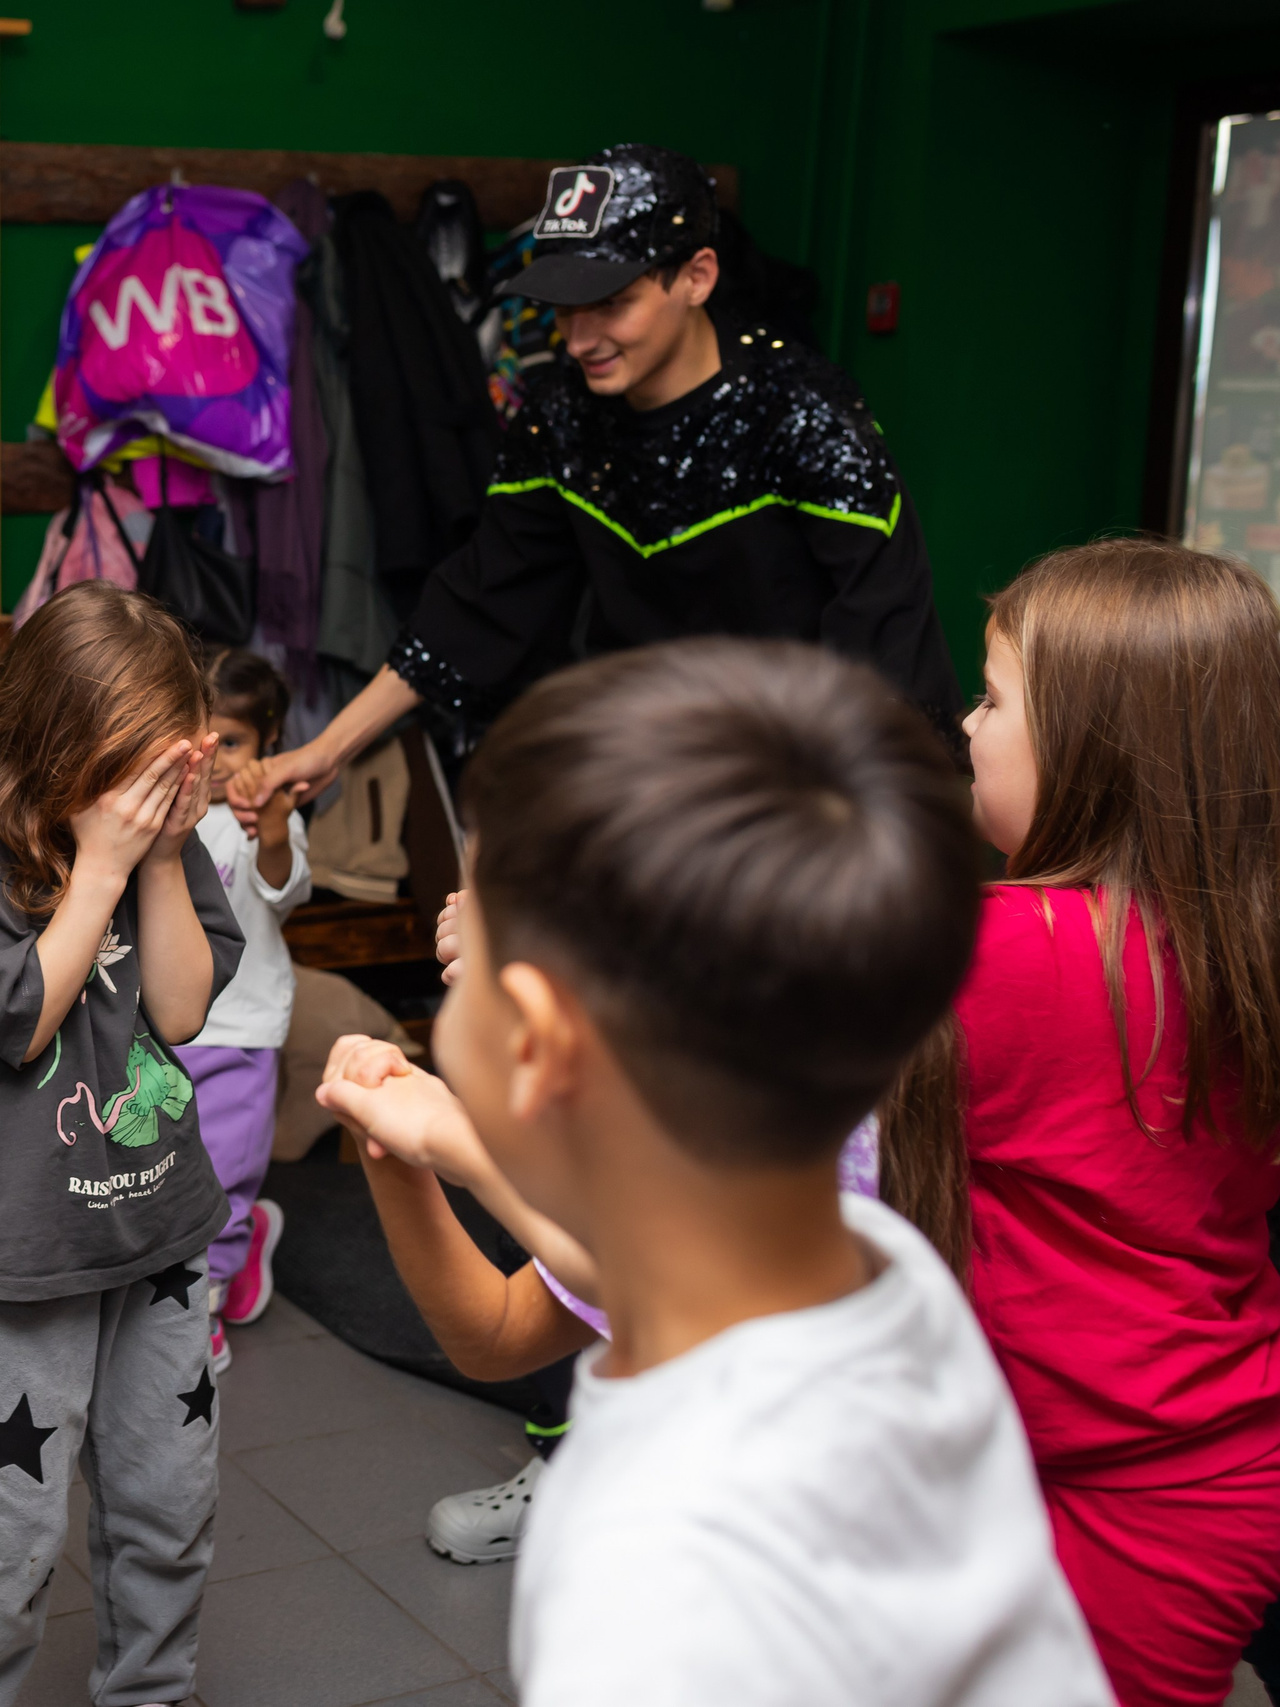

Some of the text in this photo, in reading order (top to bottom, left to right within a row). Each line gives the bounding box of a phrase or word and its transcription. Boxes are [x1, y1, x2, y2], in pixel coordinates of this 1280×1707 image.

[543, 218, 588, 232] TikTok
[88, 262, 240, 350] WB
[140, 1151, 176, 1185] FLIGHT
